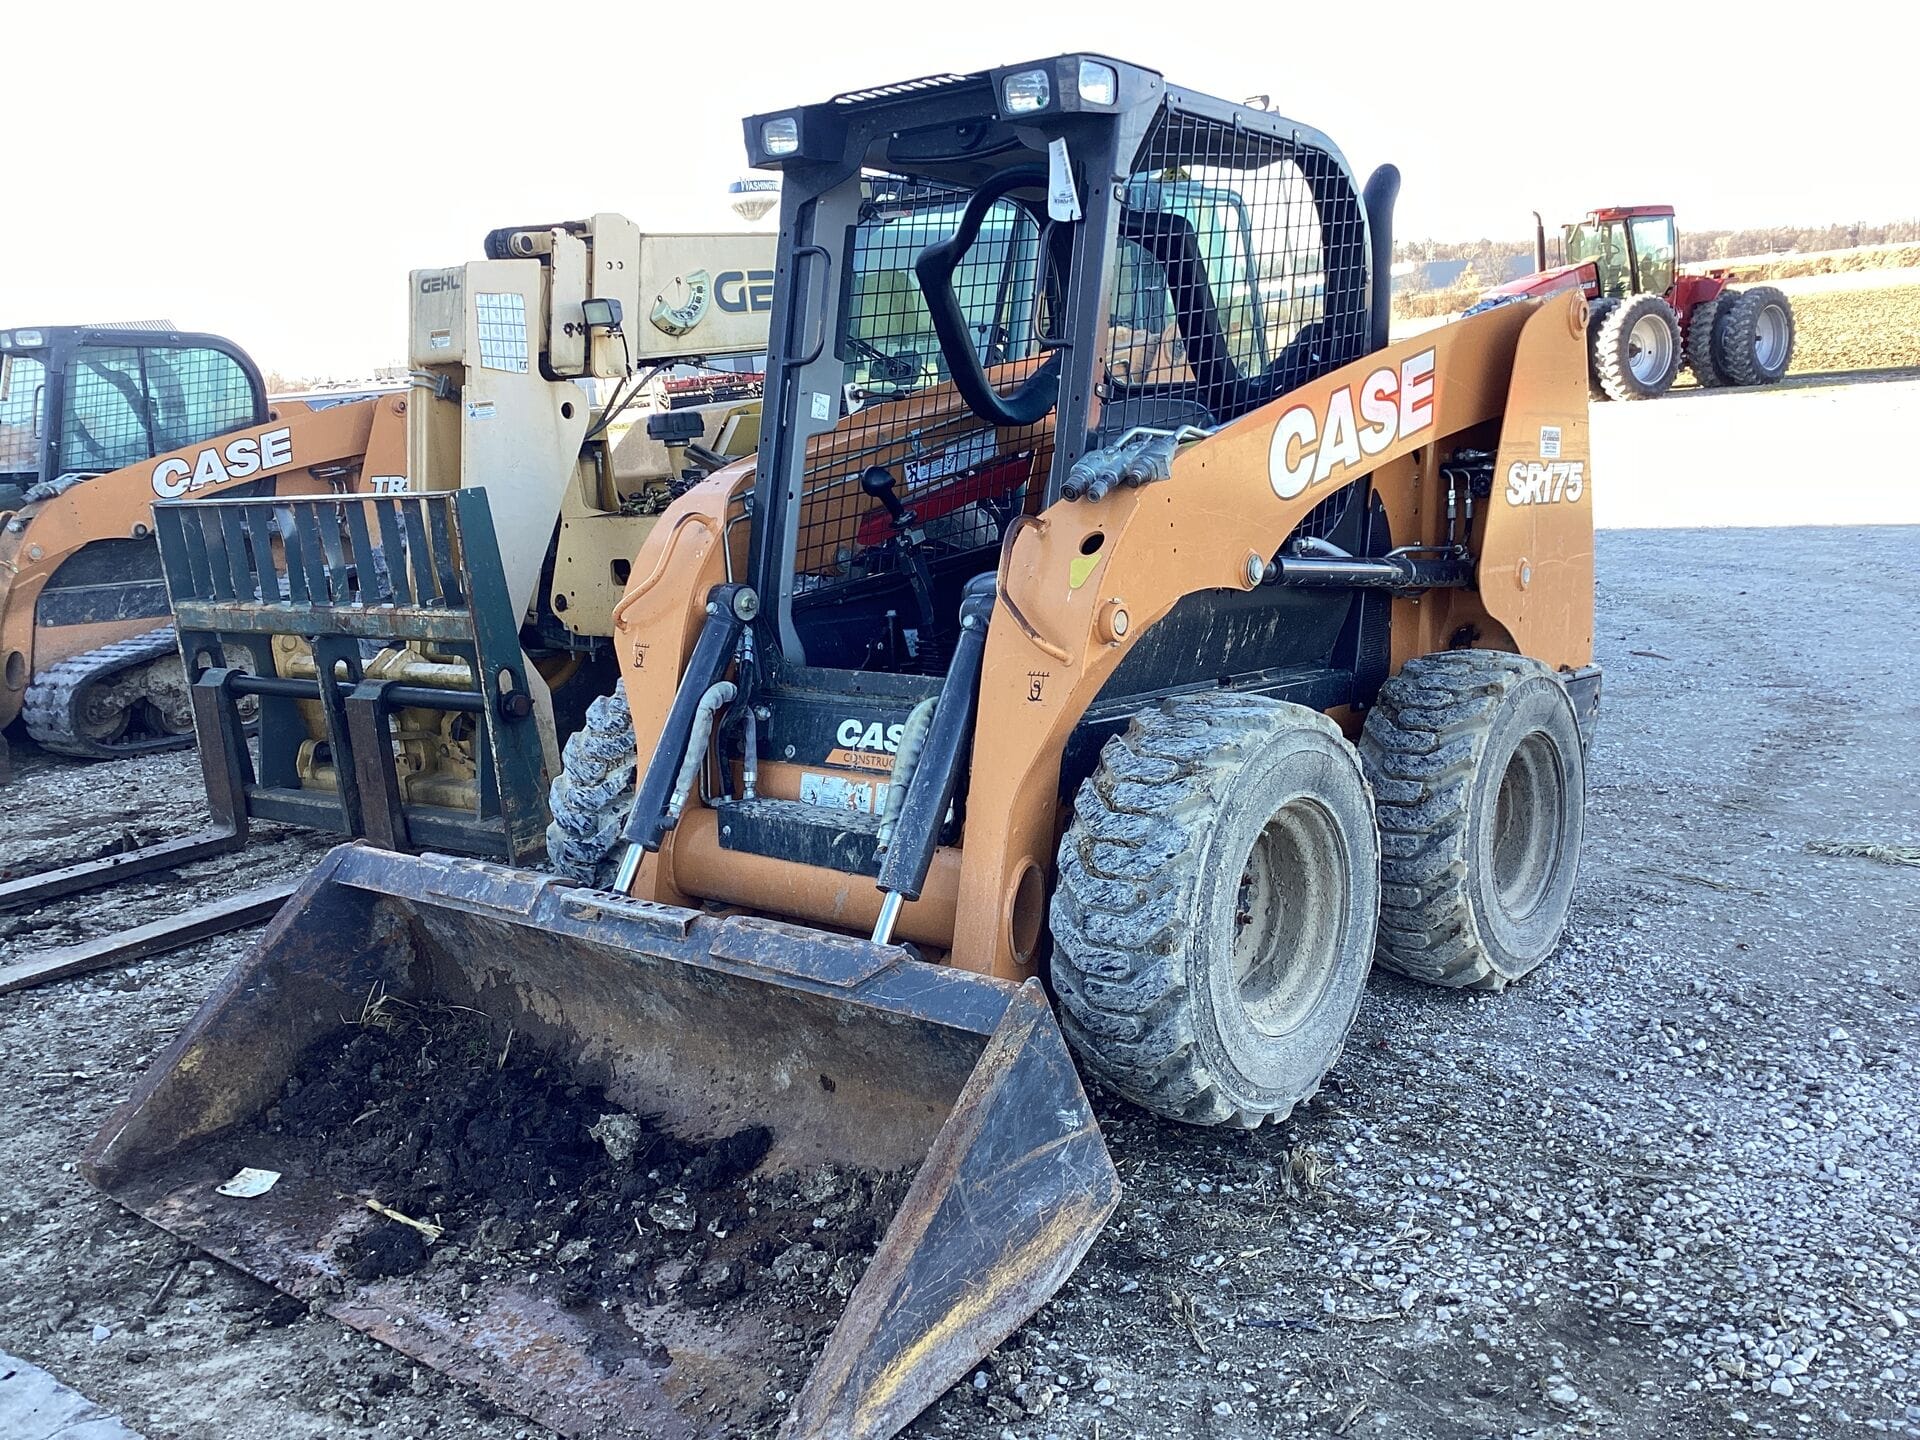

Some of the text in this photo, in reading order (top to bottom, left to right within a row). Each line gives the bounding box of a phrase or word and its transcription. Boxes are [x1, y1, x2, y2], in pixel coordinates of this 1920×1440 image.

[421, 275, 460, 294] GEHL
[1268, 345, 1436, 501] CASE
[151, 426, 293, 498] CASE
[1505, 460, 1585, 507] SR175
[837, 719, 906, 753] CAS
